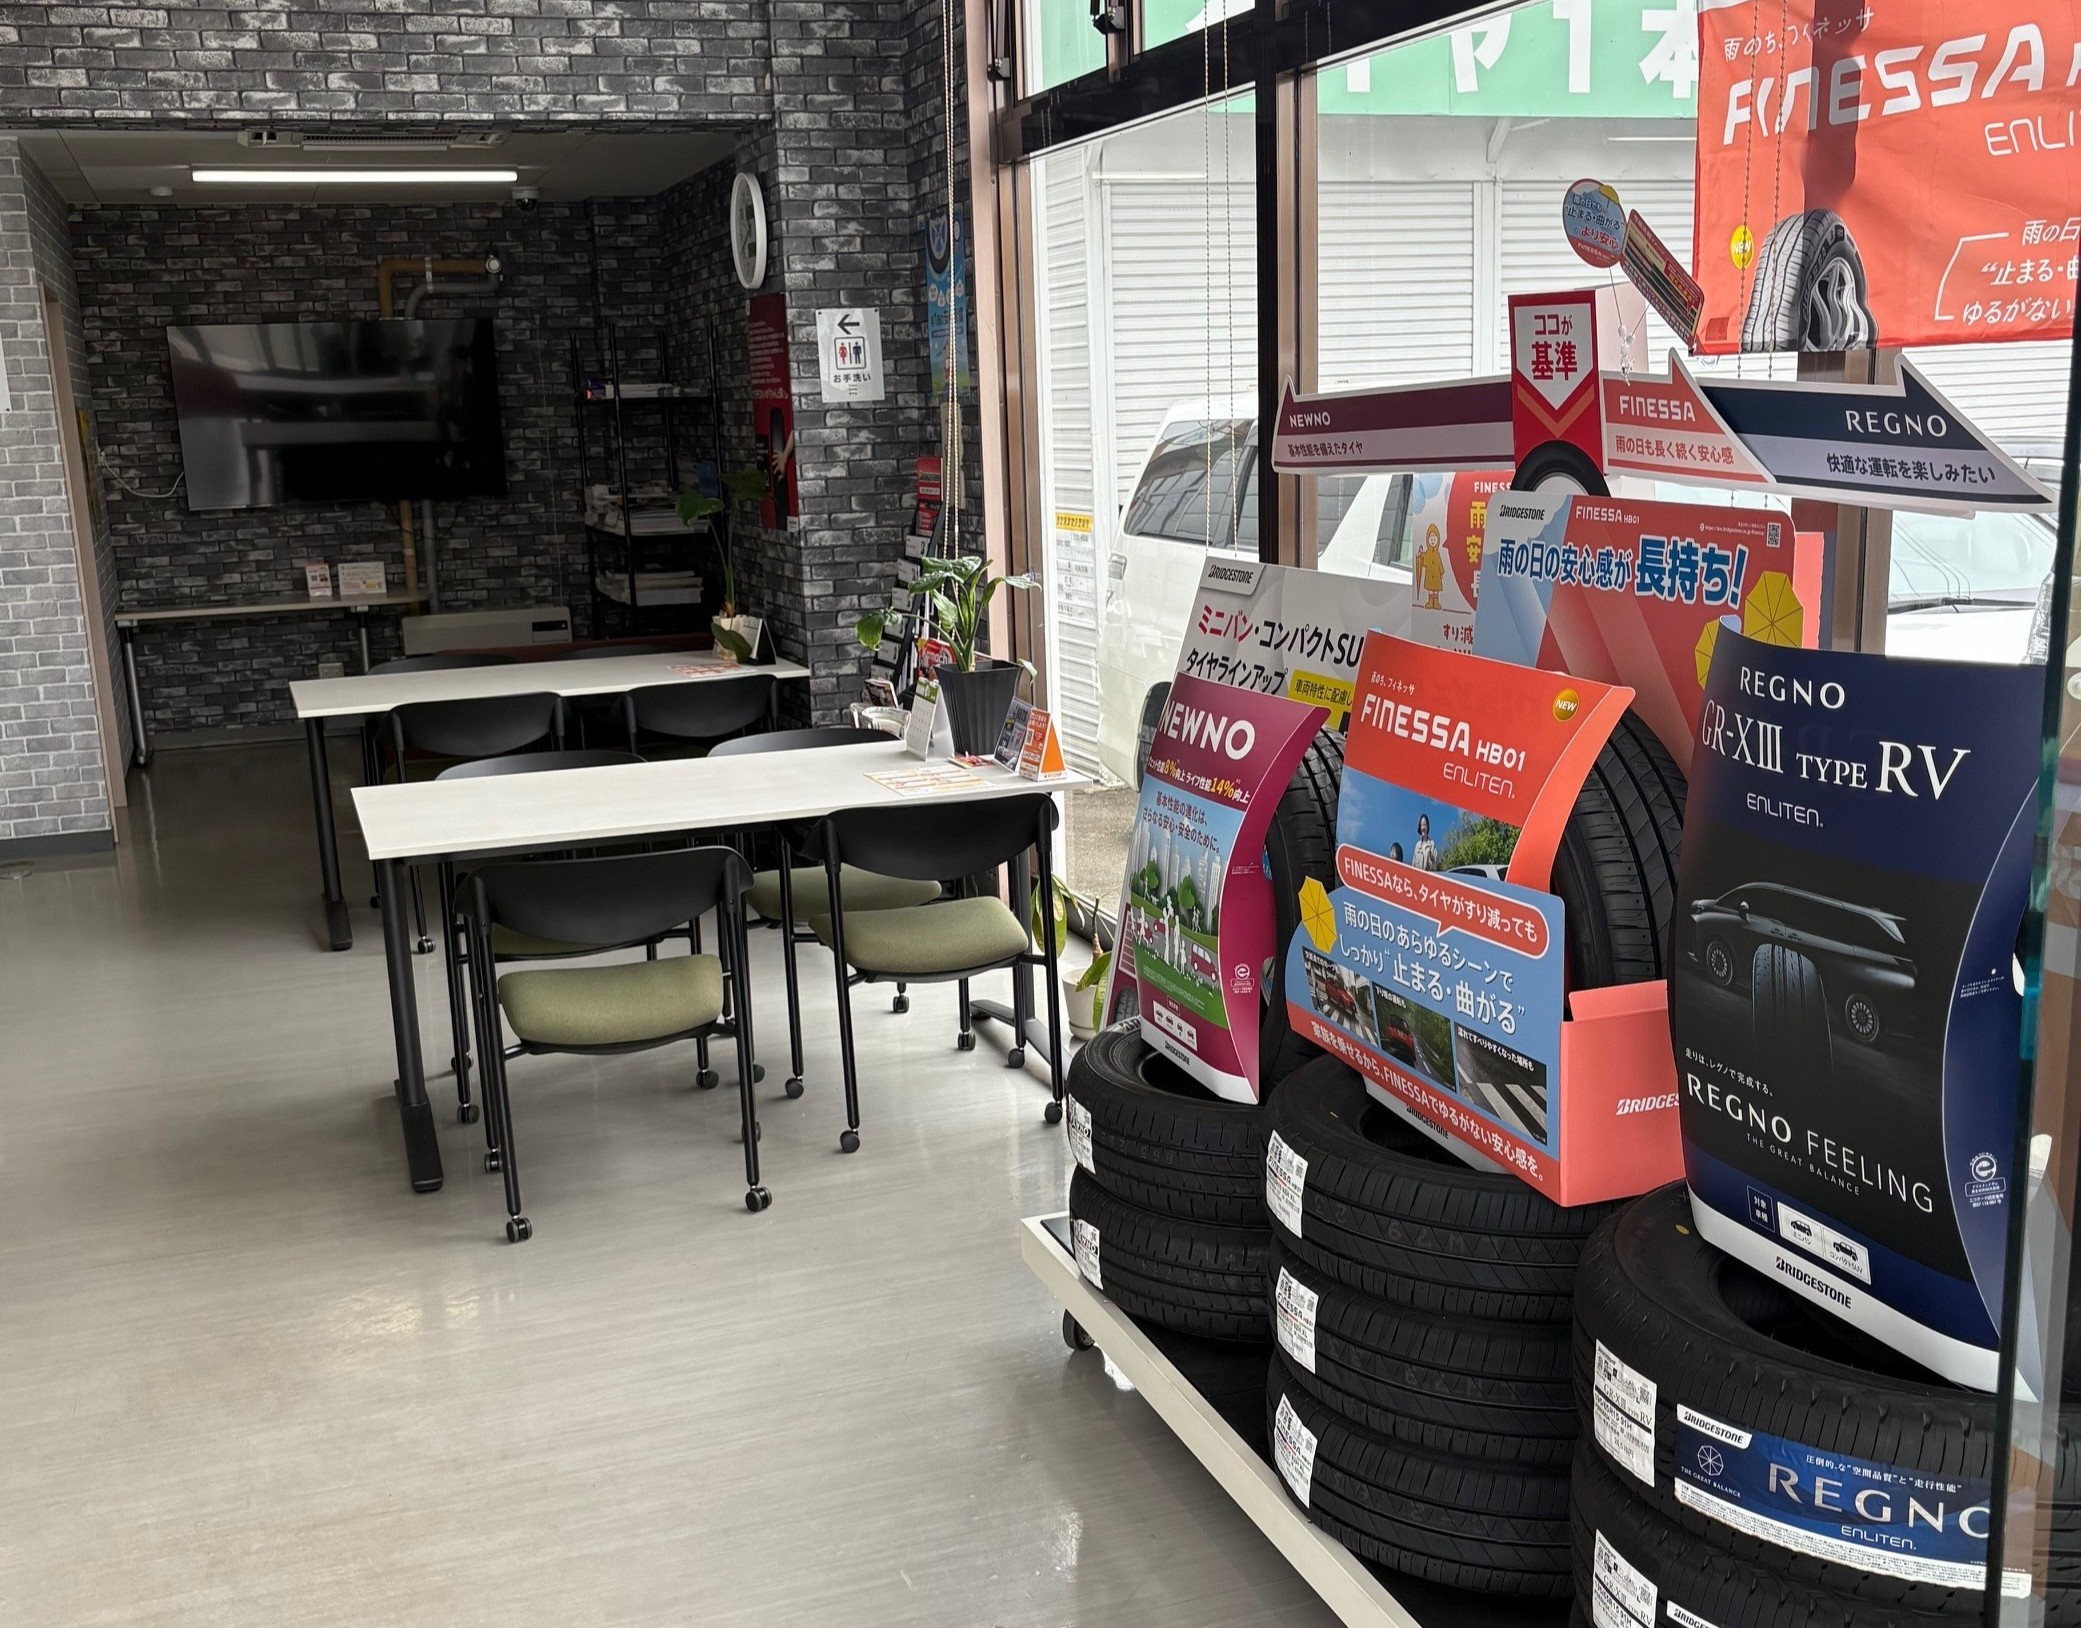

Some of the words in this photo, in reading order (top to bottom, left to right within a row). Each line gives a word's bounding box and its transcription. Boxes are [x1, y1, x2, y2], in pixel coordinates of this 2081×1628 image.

[1722, 22, 2046, 146] FINESSA
[1984, 110, 2081, 156] ENLI
[1731, 239, 1753, 256] NEW
[1533, 314, 1573, 336] ココが
[833, 373, 871, 383] お手洗い
[1531, 341, 1578, 381] 基準
[1289, 412, 1331, 428] NEWNO
[1619, 395, 1696, 422] FINESSA
[1845, 410, 1947, 437] REGNO
[1615, 435, 1735, 465] 雨の日も長く続く安心感
[1827, 453, 1995, 484] 快適な運転を楽しみたい
[1499, 504, 1545, 521] BRIDGESTONE
[1575, 505, 1622, 523] FINESSA
[1208, 564, 1254, 585] BRIDGESTONE
[1186, 648, 1288, 695] タイヤラインアップ
[1739, 666, 1846, 709] REGNO
[1555, 699, 1578, 712] NEW
[1159, 701, 1255, 760] NEWNO
[1360, 693, 1471, 757] FINESSA
[1475, 738, 1527, 773] HB01
[1795, 752, 1867, 789] TYPE
[1875, 741, 1971, 800] RV
[1344, 857, 1538, 943] FINESSAなら、タイヤがすり減っても
[1343, 901, 1514, 992] 雨の日のあらゆるシーンで
[1685, 1047, 1774, 1097] 走りは、レグノで完成する。
[1687, 1072, 1791, 1144] REGNO
[1807, 1129, 1933, 1213] FEELING
[1746, 1133, 1764, 1149] THE
[1770, 1144, 1803, 1168] GREAT
[1809, 1163, 1860, 1197] BALANCE
[1776, 1256, 1852, 1310] BRIDGESTONE
[1683, 1411, 1744, 1444] BRIDGESTONE
[1681, 1465, 1692, 1477] THE
[1693, 1472, 1712, 1486] GREAT
[1713, 1481, 1741, 1499] BALANCE
[1768, 1462, 1990, 1539] REGNO
